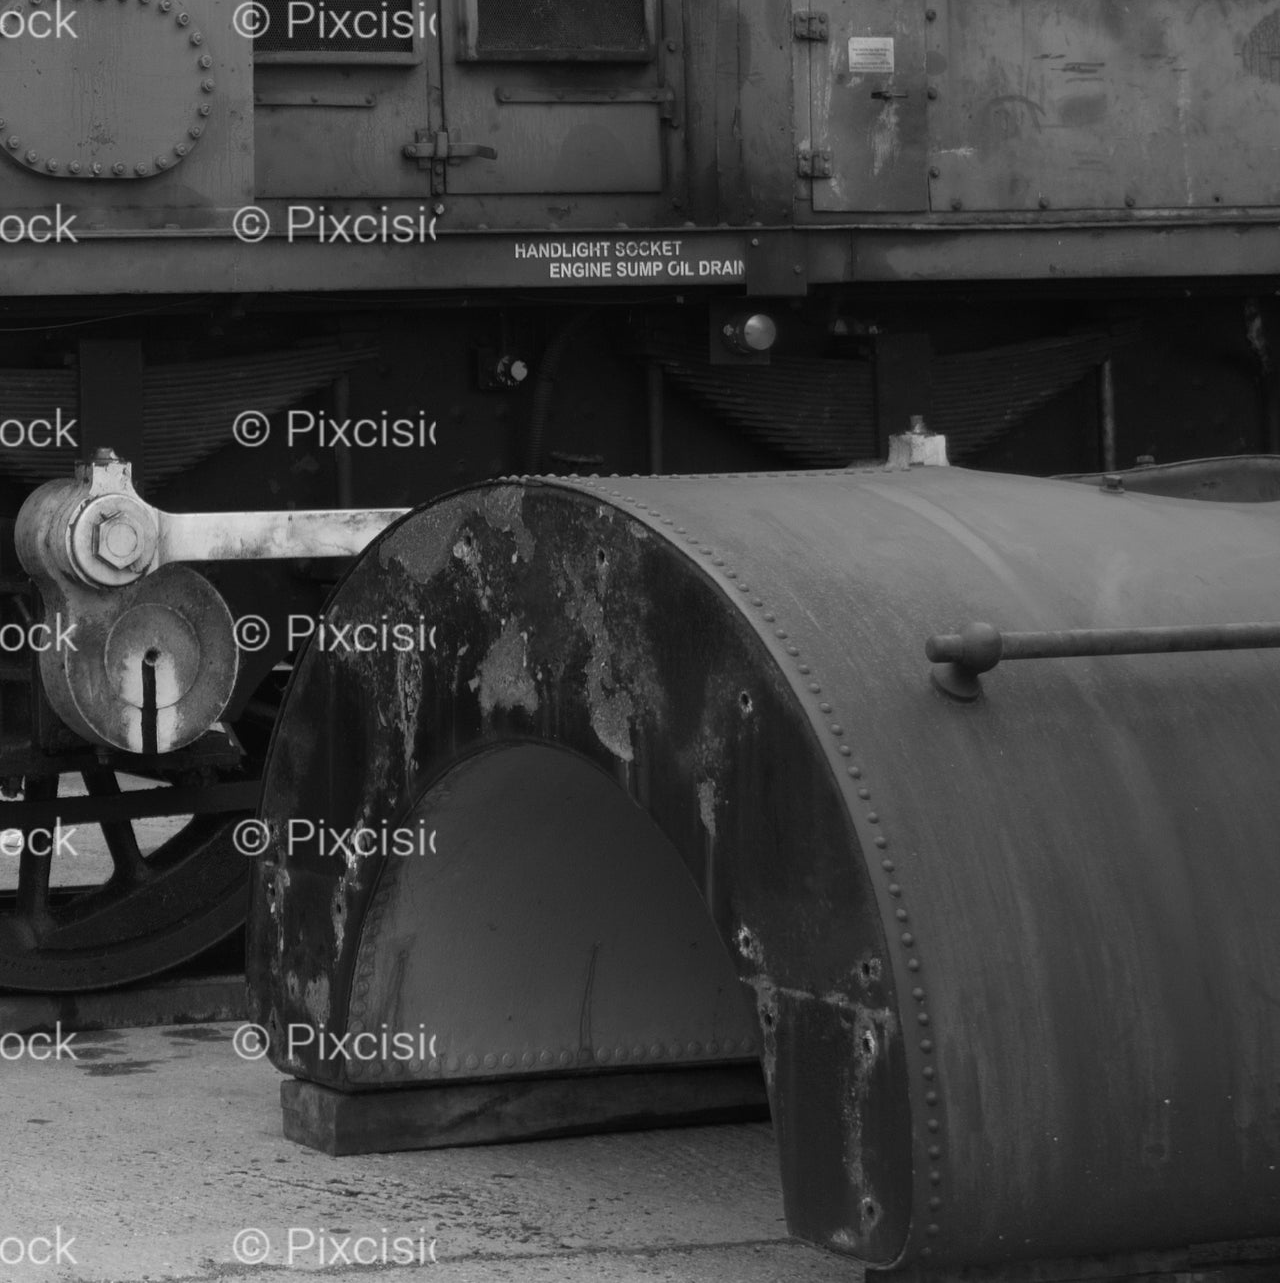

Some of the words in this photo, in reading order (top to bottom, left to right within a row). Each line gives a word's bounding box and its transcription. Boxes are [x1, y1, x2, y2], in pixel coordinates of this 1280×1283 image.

[515, 241, 611, 259] HANDLIGHT
[615, 241, 682, 257] SOCKET
[549, 261, 612, 278] ENGINE
[616, 261, 663, 277] SUMP
[667, 261, 694, 276] OIL
